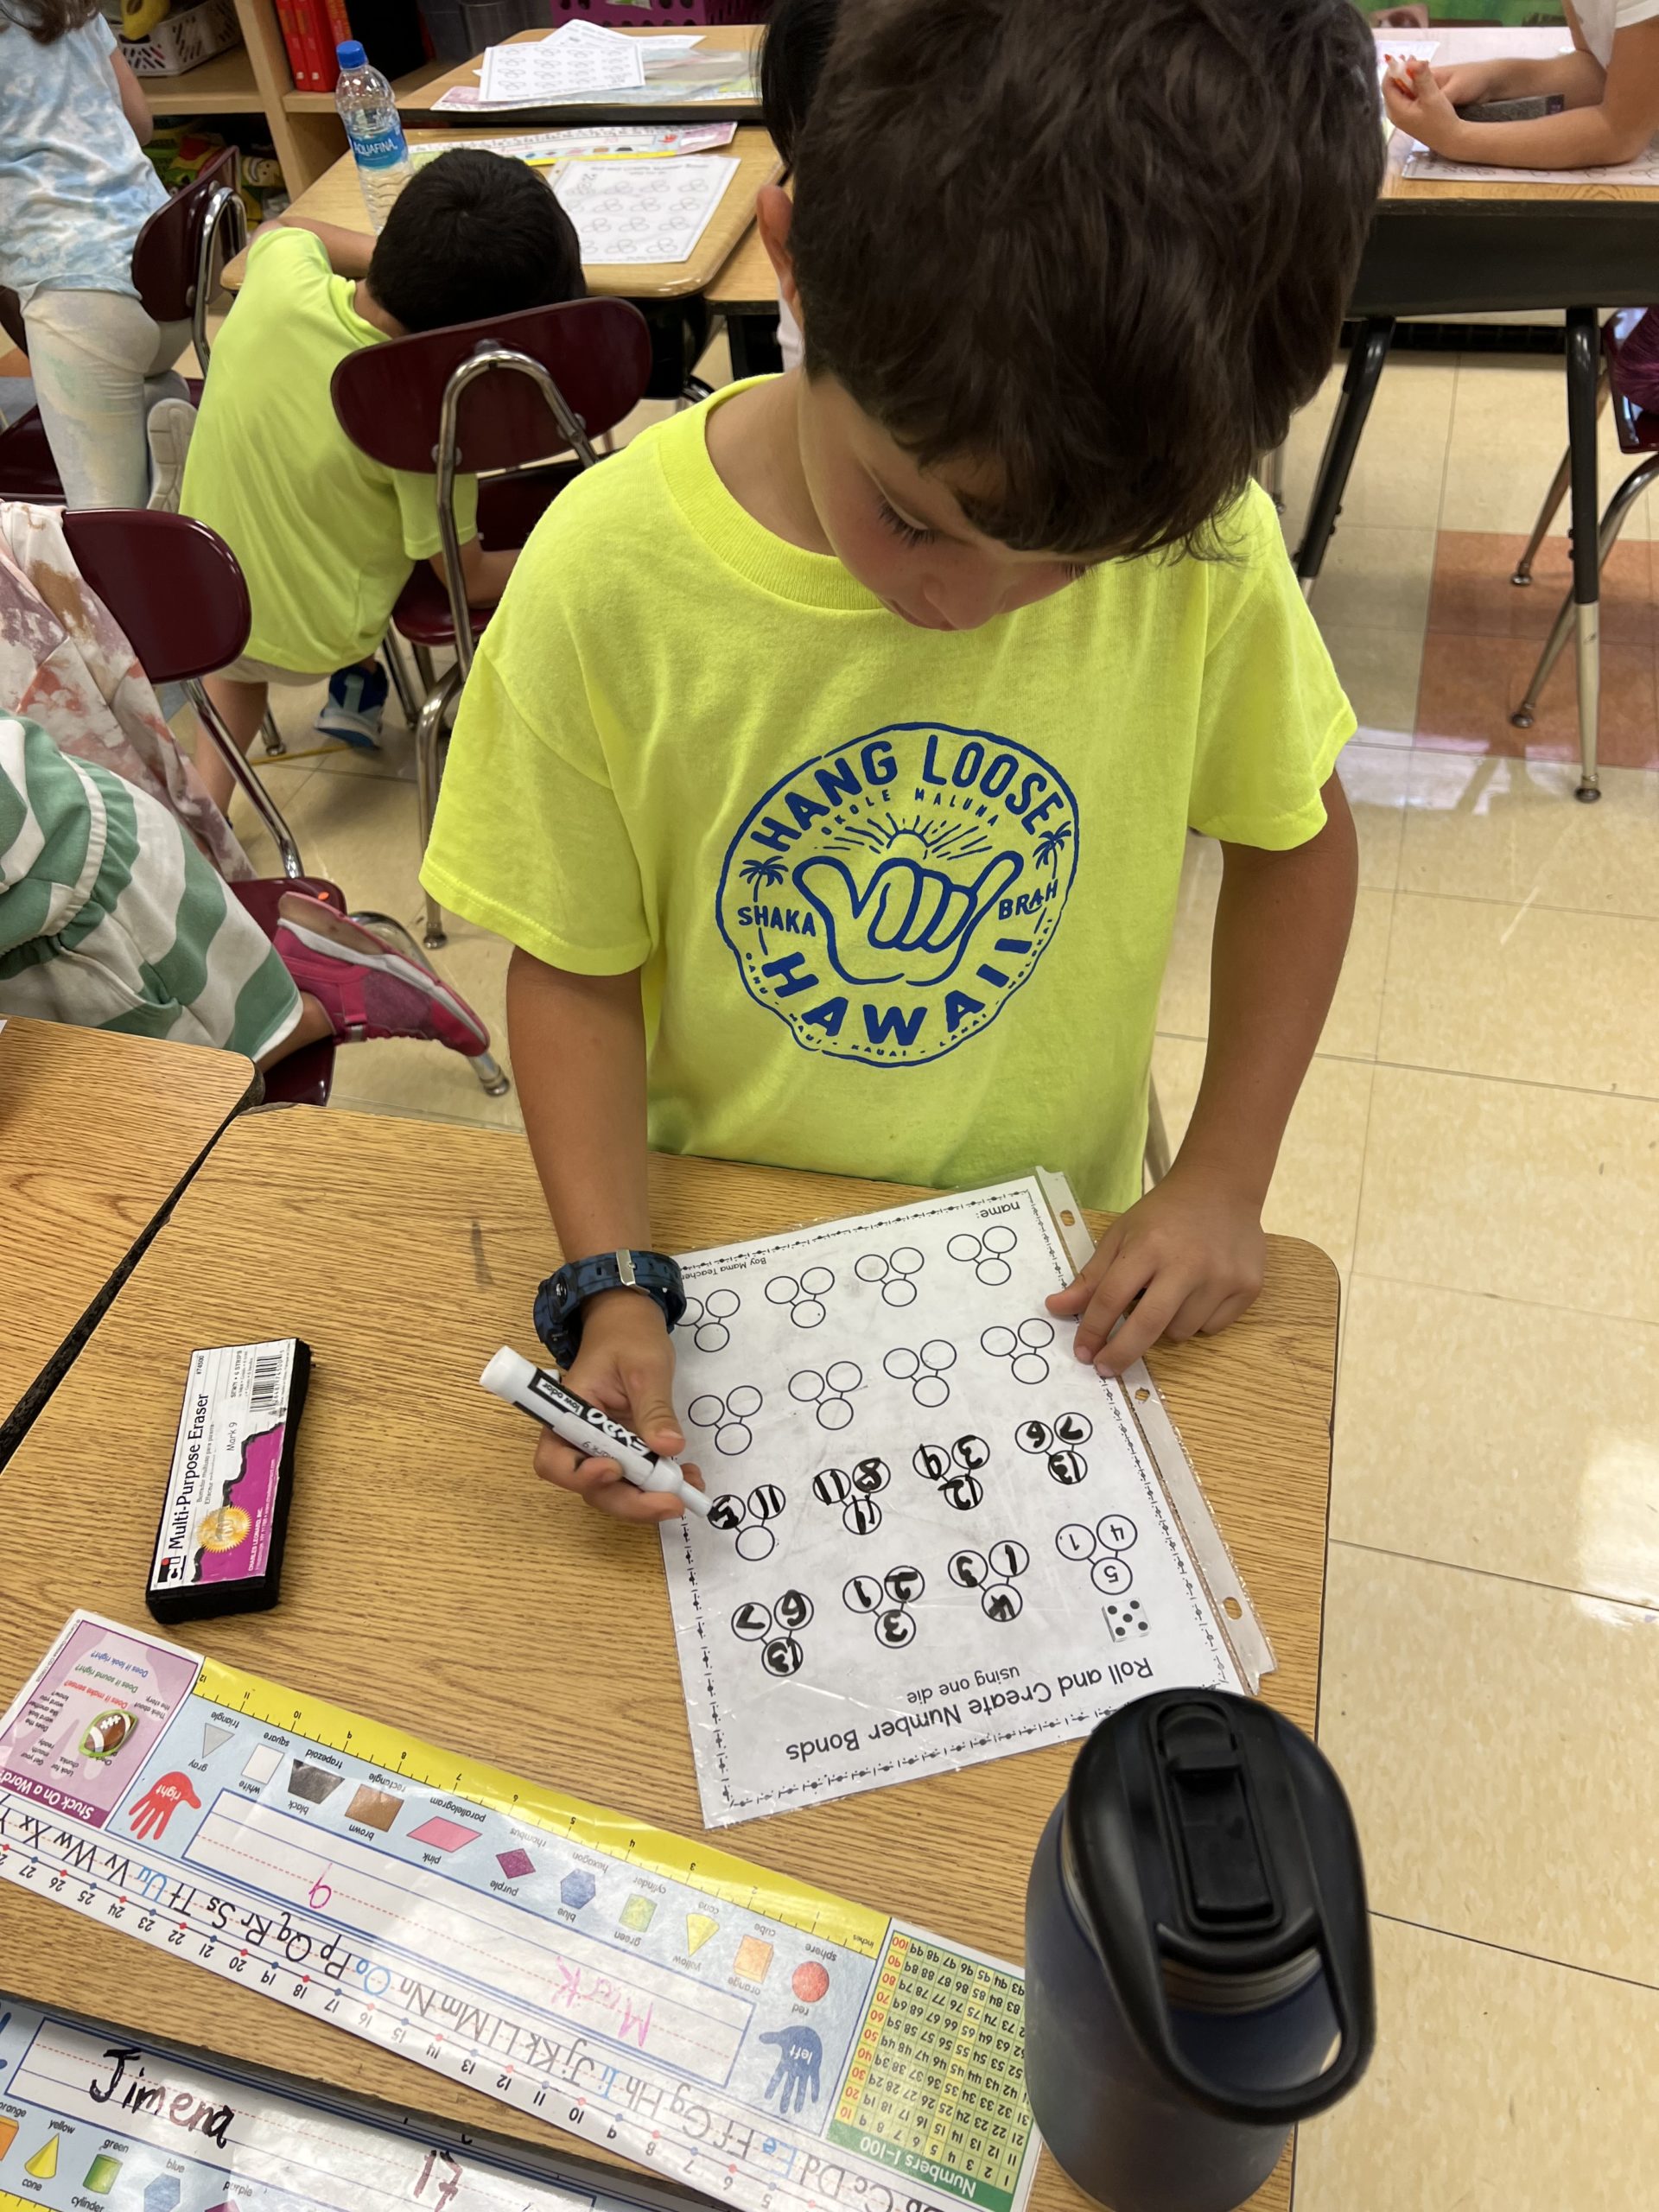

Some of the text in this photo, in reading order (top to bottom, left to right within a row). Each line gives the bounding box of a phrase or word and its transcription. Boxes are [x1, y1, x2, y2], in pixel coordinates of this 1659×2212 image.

[751, 735, 1064, 852] HANG LOOSE
[821, 788, 999, 836] OKOLE MALUNA
[998, 880, 1058, 919] BRAH
[738, 906, 817, 937] SHAKA
[762, 938, 1033, 1046] HAWAII
[788, 1014, 823, 1045] MAUI
[851, 1044, 906, 1058] KAUAI
[939, 1013, 988, 1048] LANAI
[976, 1200, 1020, 1221] name:
[681, 1256, 767, 1281] Boy Mama Teacher
[542, 1382, 581, 1413] low odor
[226, 1431, 238, 1452] Mark
[586, 1407, 652, 1457] EXPO
[582, 1440, 589, 1448] 9
[168, 1394, 209, 1550] Multi-Purpose Eraser
[1109, 1524, 1125, 1541] 4
[1103, 1566, 1119, 1584] 5
[883, 1609, 907, 1642] 3
[199, 1675, 207, 1683] 12
[906, 1665, 1020, 1707] using one die
[211, 1712, 239, 1729] triangle
[294, 1711, 302, 1719] 10
[785, 1657, 1154, 1763] Roll and Create Number Bonds
[263, 1732, 290, 1748] square
[188, 1759, 208, 1774] gray
[306, 1748, 343, 1770] trapezoid
[34, 1787, 43, 1796] a
[156, 1784, 181, 1802] right
[238, 1781, 260, 1796] white
[369, 1772, 406, 1794] rectangle
[44, 1789, 60, 1806] On
[288, 1800, 309, 1815] black
[513, 1795, 519, 1803] 6
[62, 1797, 95, 1820] Stuck
[429, 1797, 486, 1823] parallelogram
[570, 1816, 576, 1825] 5
[348, 1824, 374, 1840] brown
[510, 1827, 547, 1849] rhombus
[53, 1830, 97, 1872] Ww
[629, 1840, 636, 1848] 4
[423, 1852, 442, 1866] pink
[572, 1851, 608, 1874] hexagon
[690, 1862, 696, 1871] 3
[104, 1853, 130, 1887] Vv
[137, 1866, 167, 1902] Uu
[490, 1879, 519, 1898] purple
[167, 1883, 197, 1916] Tt
[207, 1895, 235, 1929] Ss
[557, 1908, 576, 1923] blue
[241, 1912, 272, 1947] Rr
[276, 1911, 312, 1962] Qq
[613, 1930, 640, 1948] green
[320, 1934, 352, 1980] Pp
[804, 1944, 837, 1961] sphere
[892, 1936, 924, 1957] 99 100
[728, 1976, 760, 1996] orange
[791, 2005, 810, 2018] red
[199, 1943, 585, 2124] 10 11 12 17 18 19 20 21
[526, 2031, 561, 2075] Kk
[790, 2045, 813, 2065] left
[48, 2119, 75, 2134] yellow
[104, 2138, 130, 2153] green
[167, 2158, 185, 2173] blue
[906, 2153, 976, 2198] Numbers
[931, 2145, 1009, 2186] 1 2 3 4 5
[22, 2177, 42, 2191] cone
